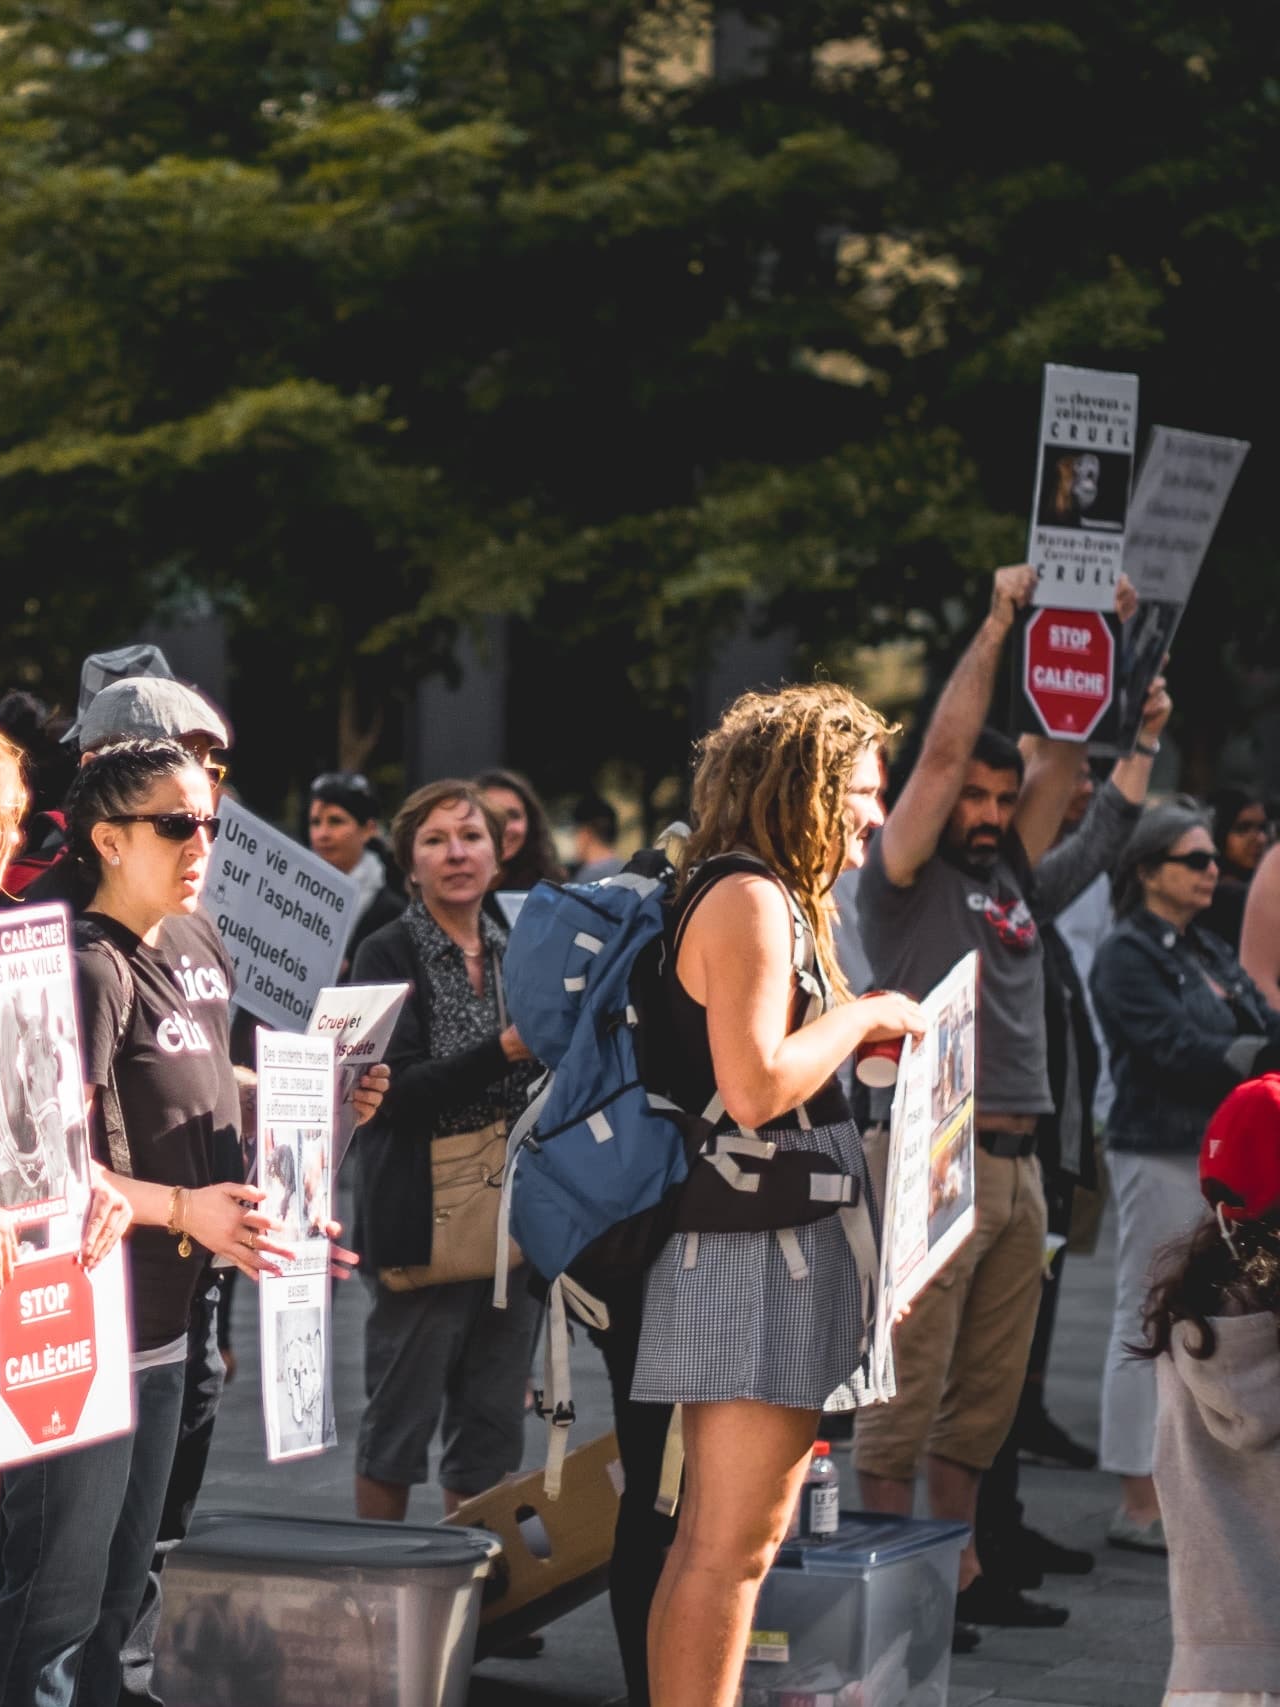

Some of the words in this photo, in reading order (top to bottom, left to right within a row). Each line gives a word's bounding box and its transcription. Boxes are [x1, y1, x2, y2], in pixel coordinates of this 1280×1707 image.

[1050, 421, 1130, 447] CRUEL
[1037, 562, 1115, 586] CRUEL
[1048, 625, 1092, 649] STOP
[225, 818, 258, 855] Une
[266, 849, 289, 875] vie
[295, 870, 345, 914] morne
[222, 858, 251, 888] sur
[256, 876, 334, 946] l'asphalte,
[0, 922, 64, 953] CALÈCHES
[217, 912, 309, 983] quelquefois
[8, 961, 29, 981] MA
[33, 954, 63, 977] VILLE
[317, 1014, 348, 1032] Cruel
[349, 1015, 362, 1029] et
[20, 1282, 70, 1318] STOP
[5, 1339, 93, 1385] CALÈCHE
